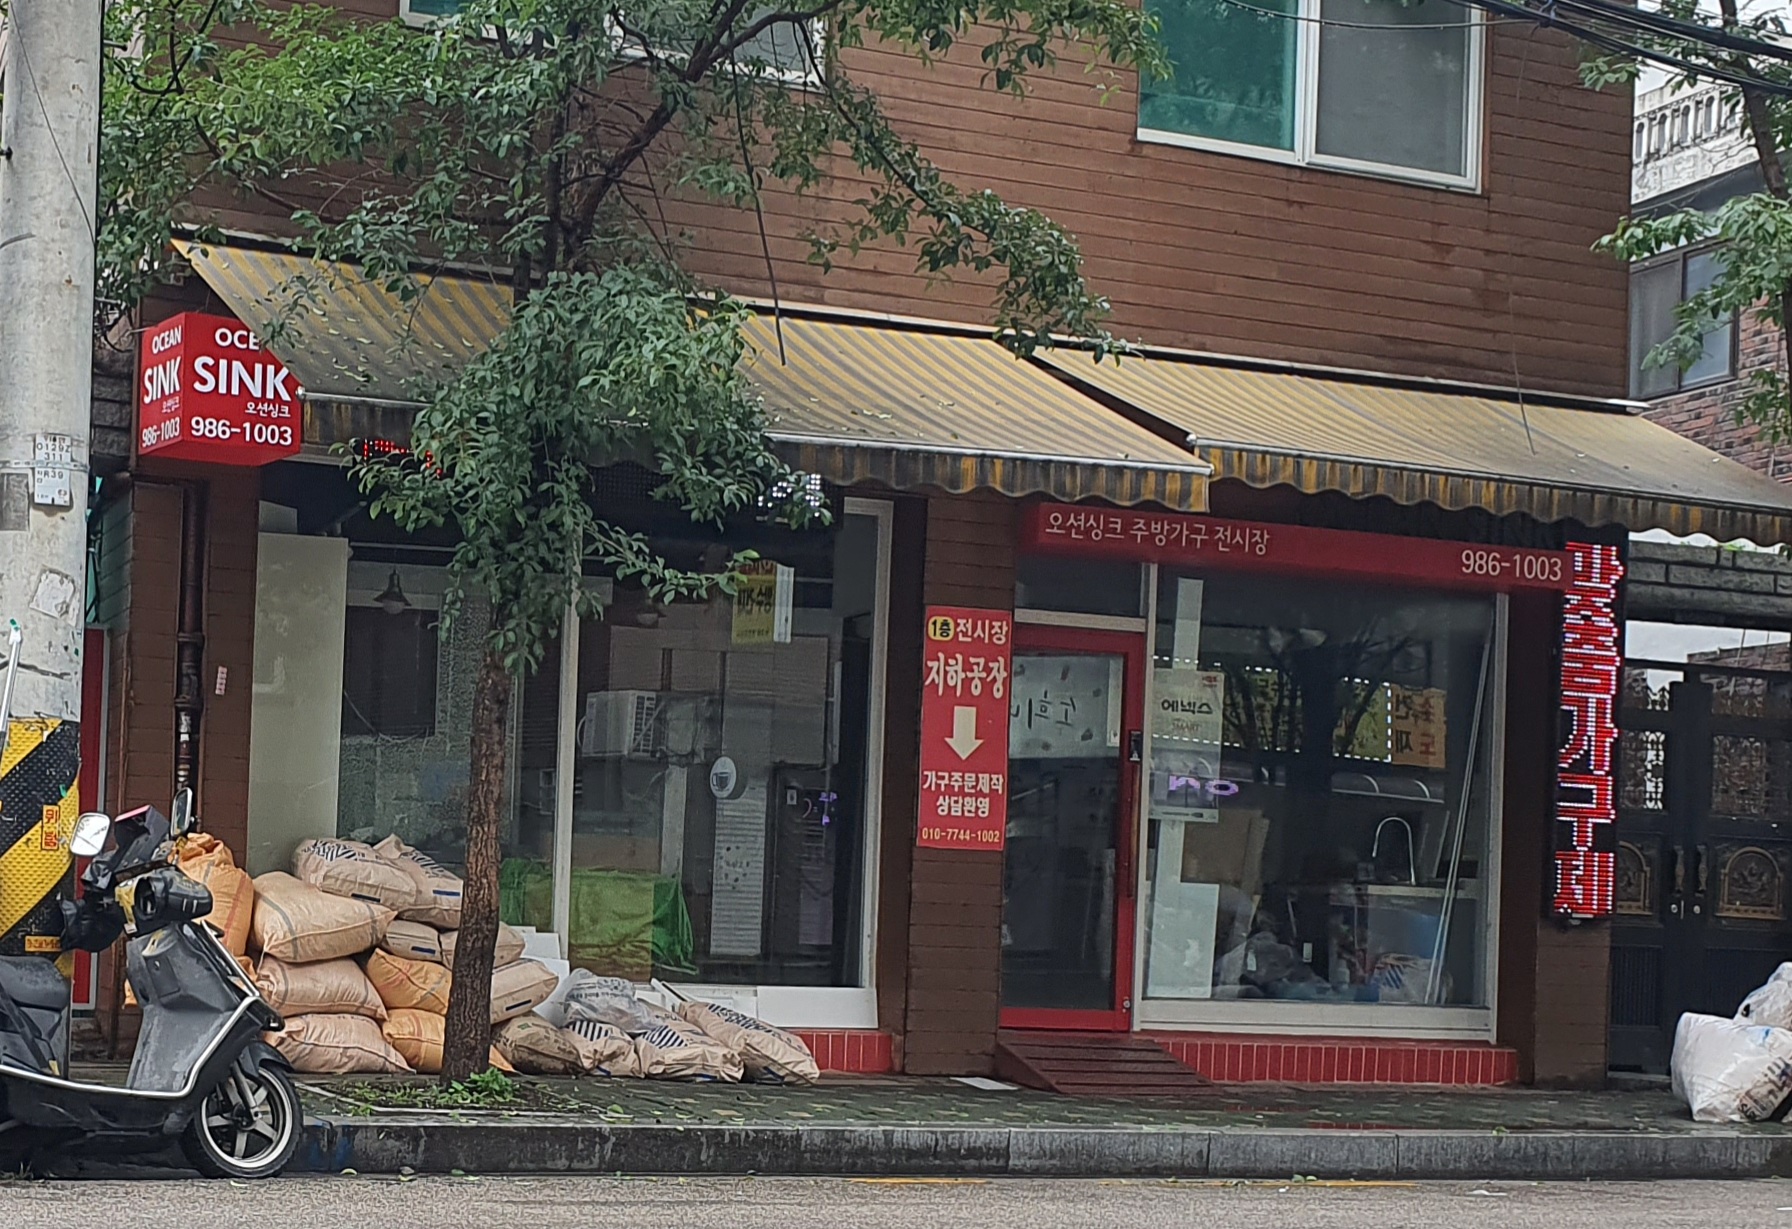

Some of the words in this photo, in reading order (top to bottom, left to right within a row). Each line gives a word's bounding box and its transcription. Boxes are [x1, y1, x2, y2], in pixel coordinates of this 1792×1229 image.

[152, 325, 182, 354] OCEAN
[214, 328, 260, 351] OCE
[143, 356, 181, 404] SINK
[193, 356, 292, 402] SINK
[245, 402, 291, 418] 오션싱크
[142, 416, 180, 448] 986-1003
[191, 416, 292, 446] 986-1003
[1045, 512, 1124, 541] 오션싱크
[1130, 518, 1209, 549] 주방가구
[1214, 525, 1270, 556] 전시장
[1461, 549, 1562, 581] 986-1003
[931, 619, 952, 638] 1층
[956, 618, 1009, 645] 전시장
[924, 651, 1008, 699] 지하공장
[1161, 699, 1213, 715] 에넥스
[922, 771, 1004, 795] 가구주문제작
[936, 795, 990, 818] 상담환영
[922, 827, 1000, 843] 010-7744-1002
